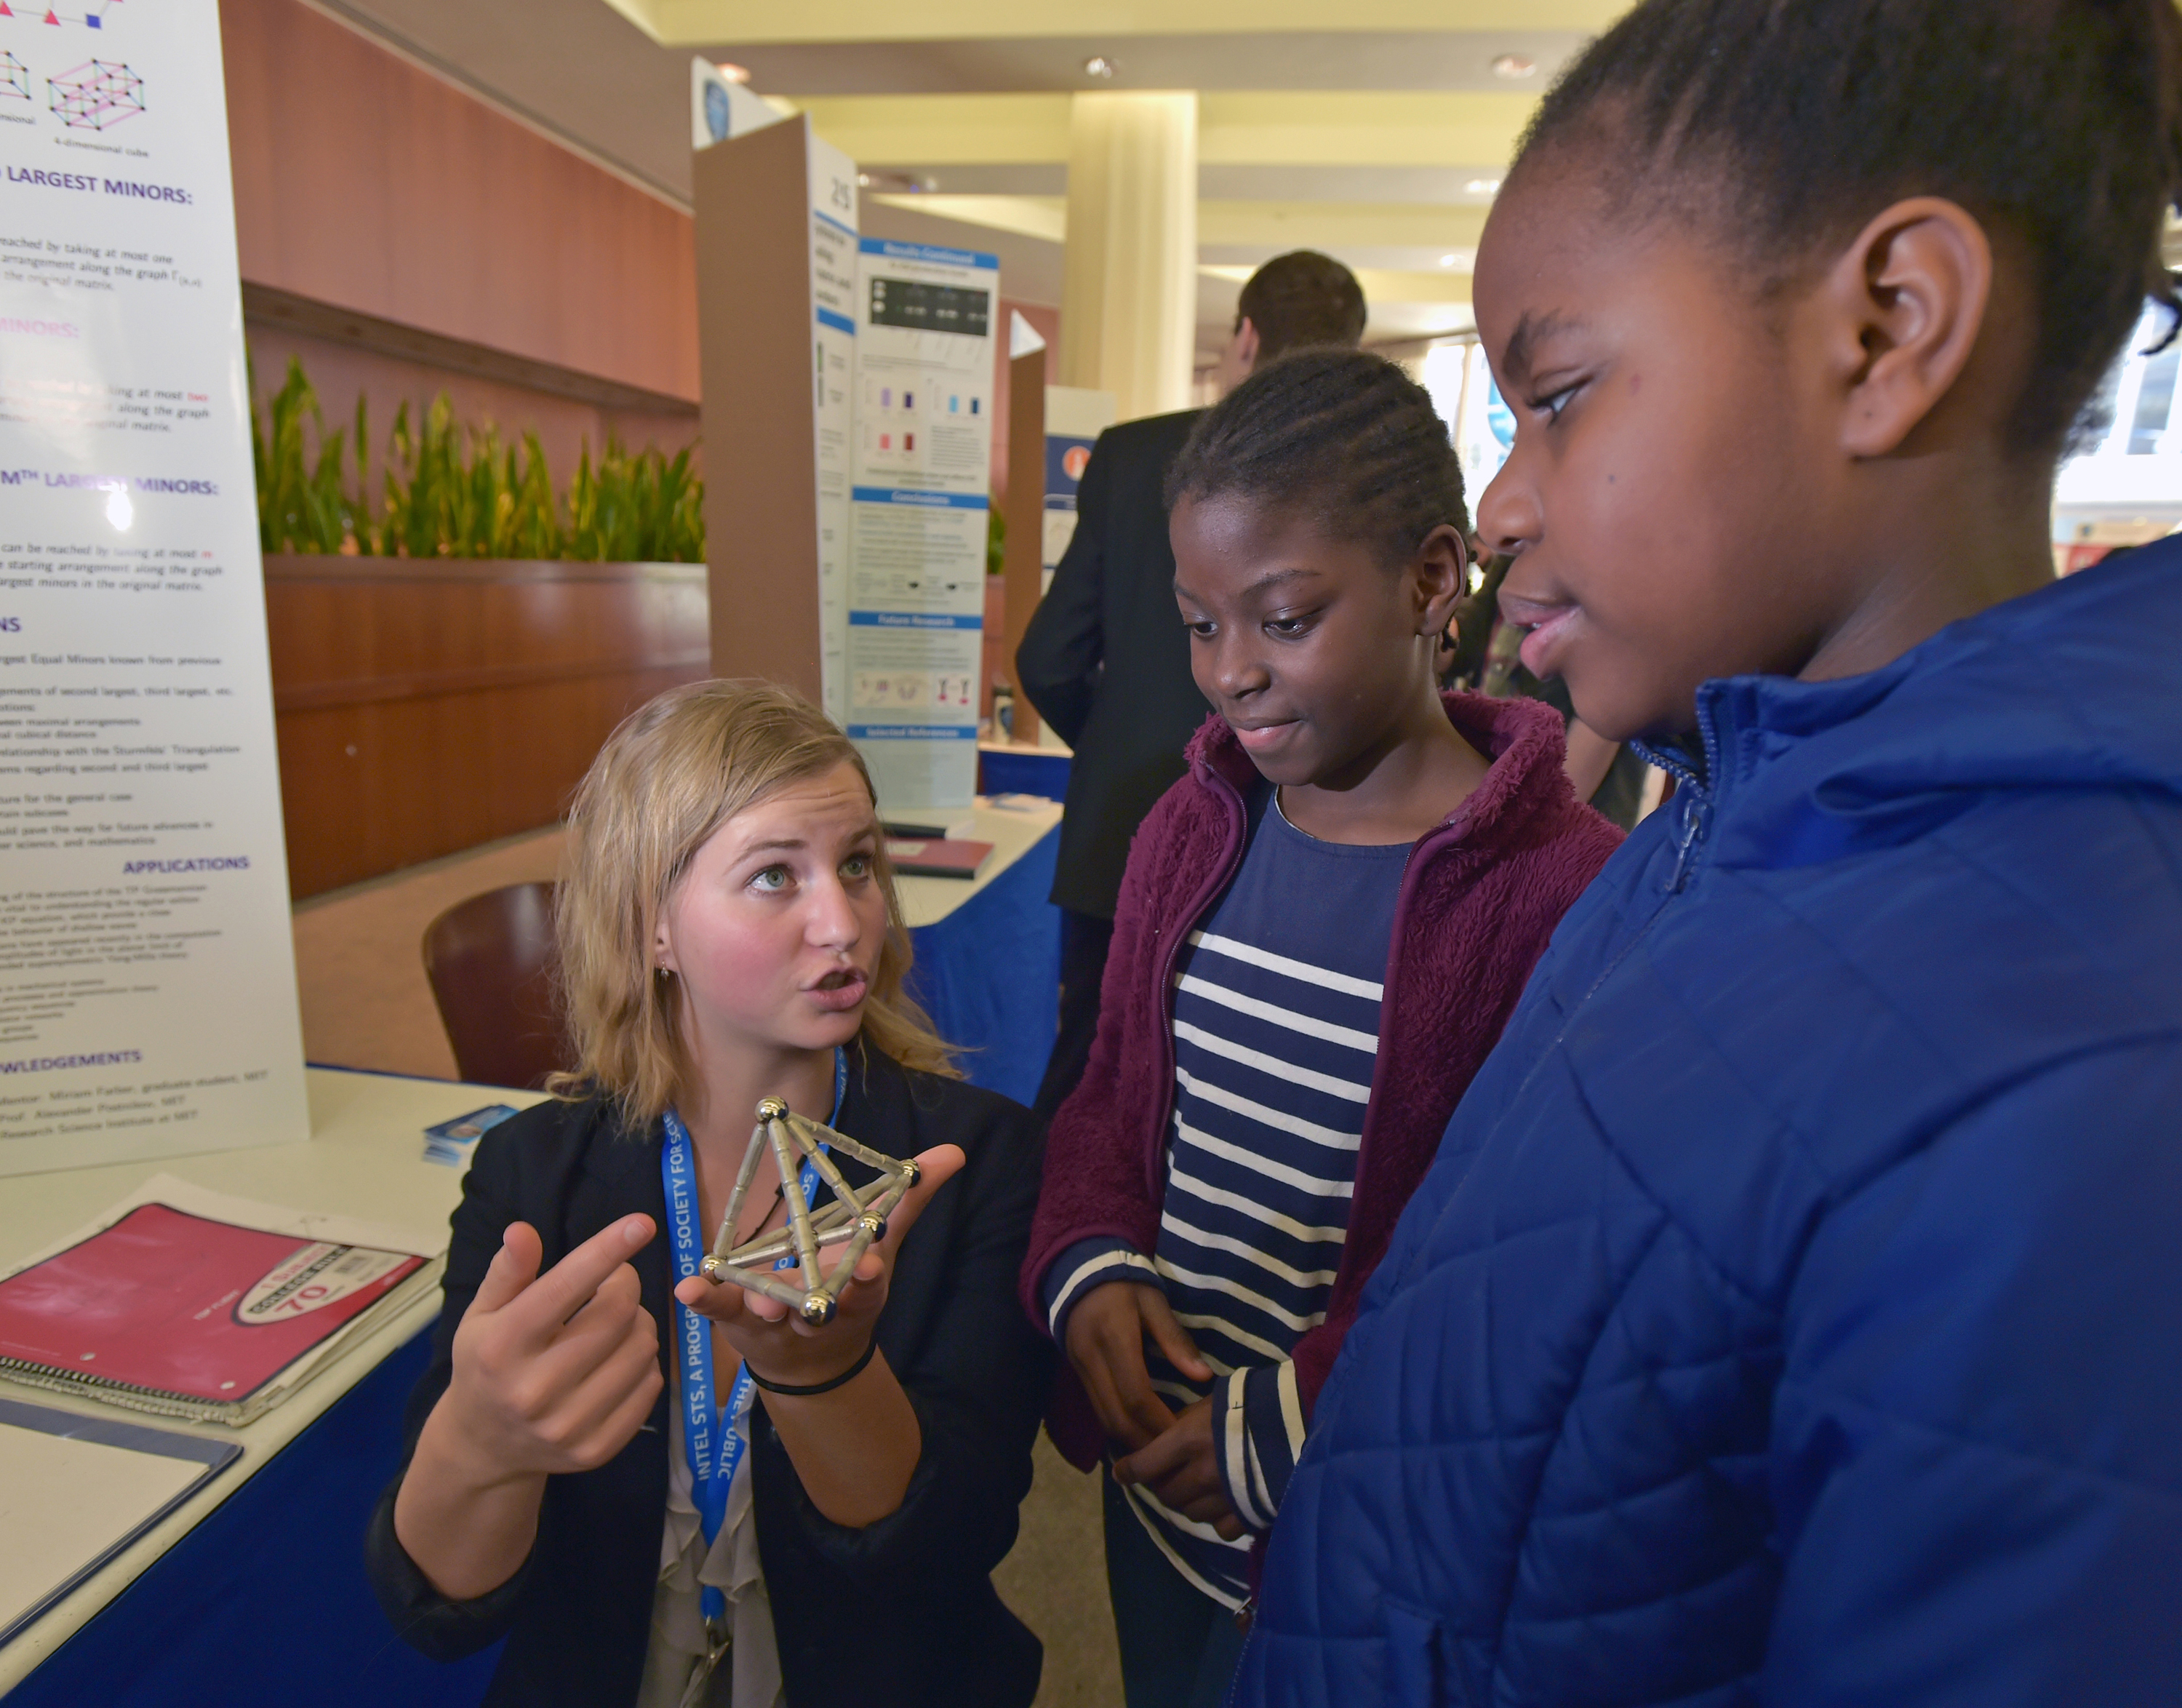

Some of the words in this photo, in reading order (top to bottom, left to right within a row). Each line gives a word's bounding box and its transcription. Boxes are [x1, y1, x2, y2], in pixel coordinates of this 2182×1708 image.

[7, 166, 97, 192] LARGEST
[104, 179, 193, 205] MINORS:
[47, 240, 59, 252] by
[65, 243, 100, 259] taking
[105, 249, 116, 258] at
[121, 251, 148, 261] most
[153, 254, 172, 264] one
[1, 255, 75, 271] arrangement
[80, 262, 111, 276] along
[115, 264, 132, 275] the
[136, 268, 167, 282] graph
[154, 389, 182, 400] most
[118, 404, 149, 416] along
[154, 406, 172, 415] the
[177, 407, 209, 419] graph
[135, 477, 219, 495] MINORS:
[122, 855, 250, 874] APPLICATIONS
[670, 1143, 685, 1173] FOR
[672, 1178, 692, 1250] SOCIETY
[680, 1254, 695, 1277] OF
[274, 1285, 329, 1312] 70
[685, 1308, 702, 1367] PROGR
[690, 1368, 703, 1381] A
[690, 1384, 707, 1426] STS,
[695, 1427, 711, 1481] INTEL
[717, 1415, 739, 1480] UBLIC
